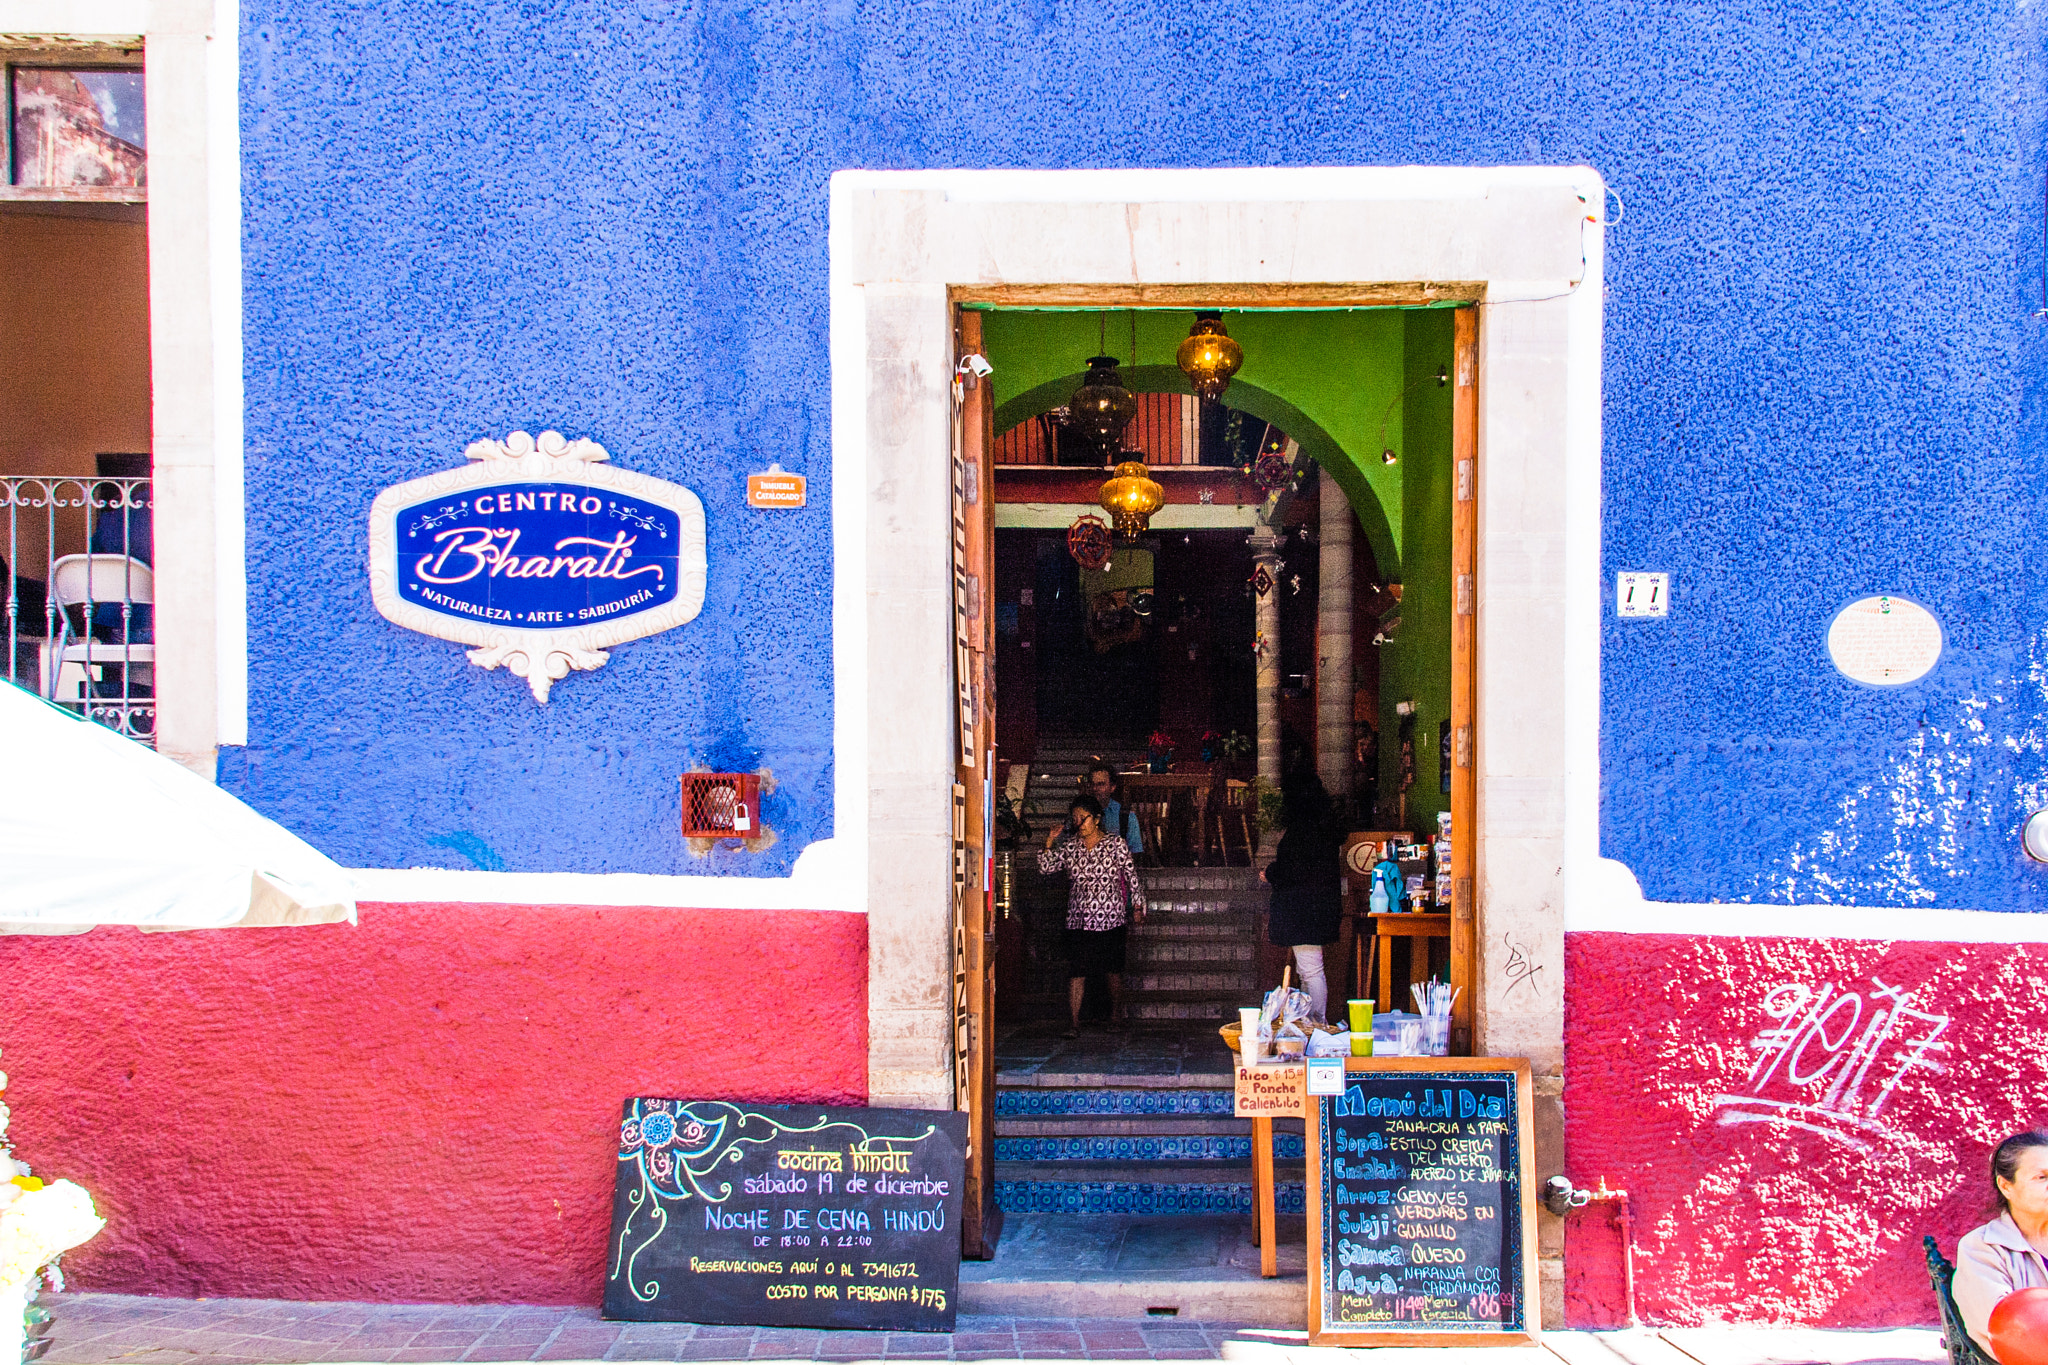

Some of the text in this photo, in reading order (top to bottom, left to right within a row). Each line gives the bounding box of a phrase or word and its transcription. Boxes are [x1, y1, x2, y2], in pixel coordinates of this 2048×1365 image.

[475, 492, 602, 515] CENTRO
[422, 587, 654, 622] NATURALEZA ARTE SABIDURÍA
[1253, 1082, 1296, 1094] Ponche
[1239, 1095, 1300, 1110] Calientito
[1335, 1084, 1507, 1118] Menú del Día
[1385, 1120, 1460, 1134] ZANAHORIA
[1478, 1121, 1509, 1136] PAPA
[1390, 1137, 1437, 1151] ESTILO
[1442, 1138, 1494, 1153] CREMA
[1408, 1152, 1493, 1168] DEL HUERTO
[1410, 1167, 1456, 1181] ADEREZO
[1460, 1169, 1475, 1181] DE
[744, 1172, 950, 1196] sábado 19 de diciembre
[1397, 1184, 1468, 1206] GENOVÉS
[705, 1200, 945, 1232] NOCHE DE CENA HINDÚ
[1395, 1205, 1495, 1221] VERDURAS EN
[1397, 1223, 1456, 1240] GUAJILLO
[754, 1234, 872, 1247] DE 18:00 A 22:00
[1412, 1242, 1466, 1264] QUESO
[690, 1257, 783, 1273] RESERVACIONES
[790, 1257, 818, 1274] AQUÍ
[841, 1264, 854, 1277] AL
[862, 1262, 919, 1278] 7341672
[1404, 1265, 1465, 1281] NARANJA
[766, 1286, 807, 1300] COSTO
[815, 1286, 839, 1300] POR
[847, 1287, 908, 1302] PERSONA
[1422, 1280, 1501, 1296] CARDAMOMO
[1341, 1305, 1474, 1321] Completo Especial
